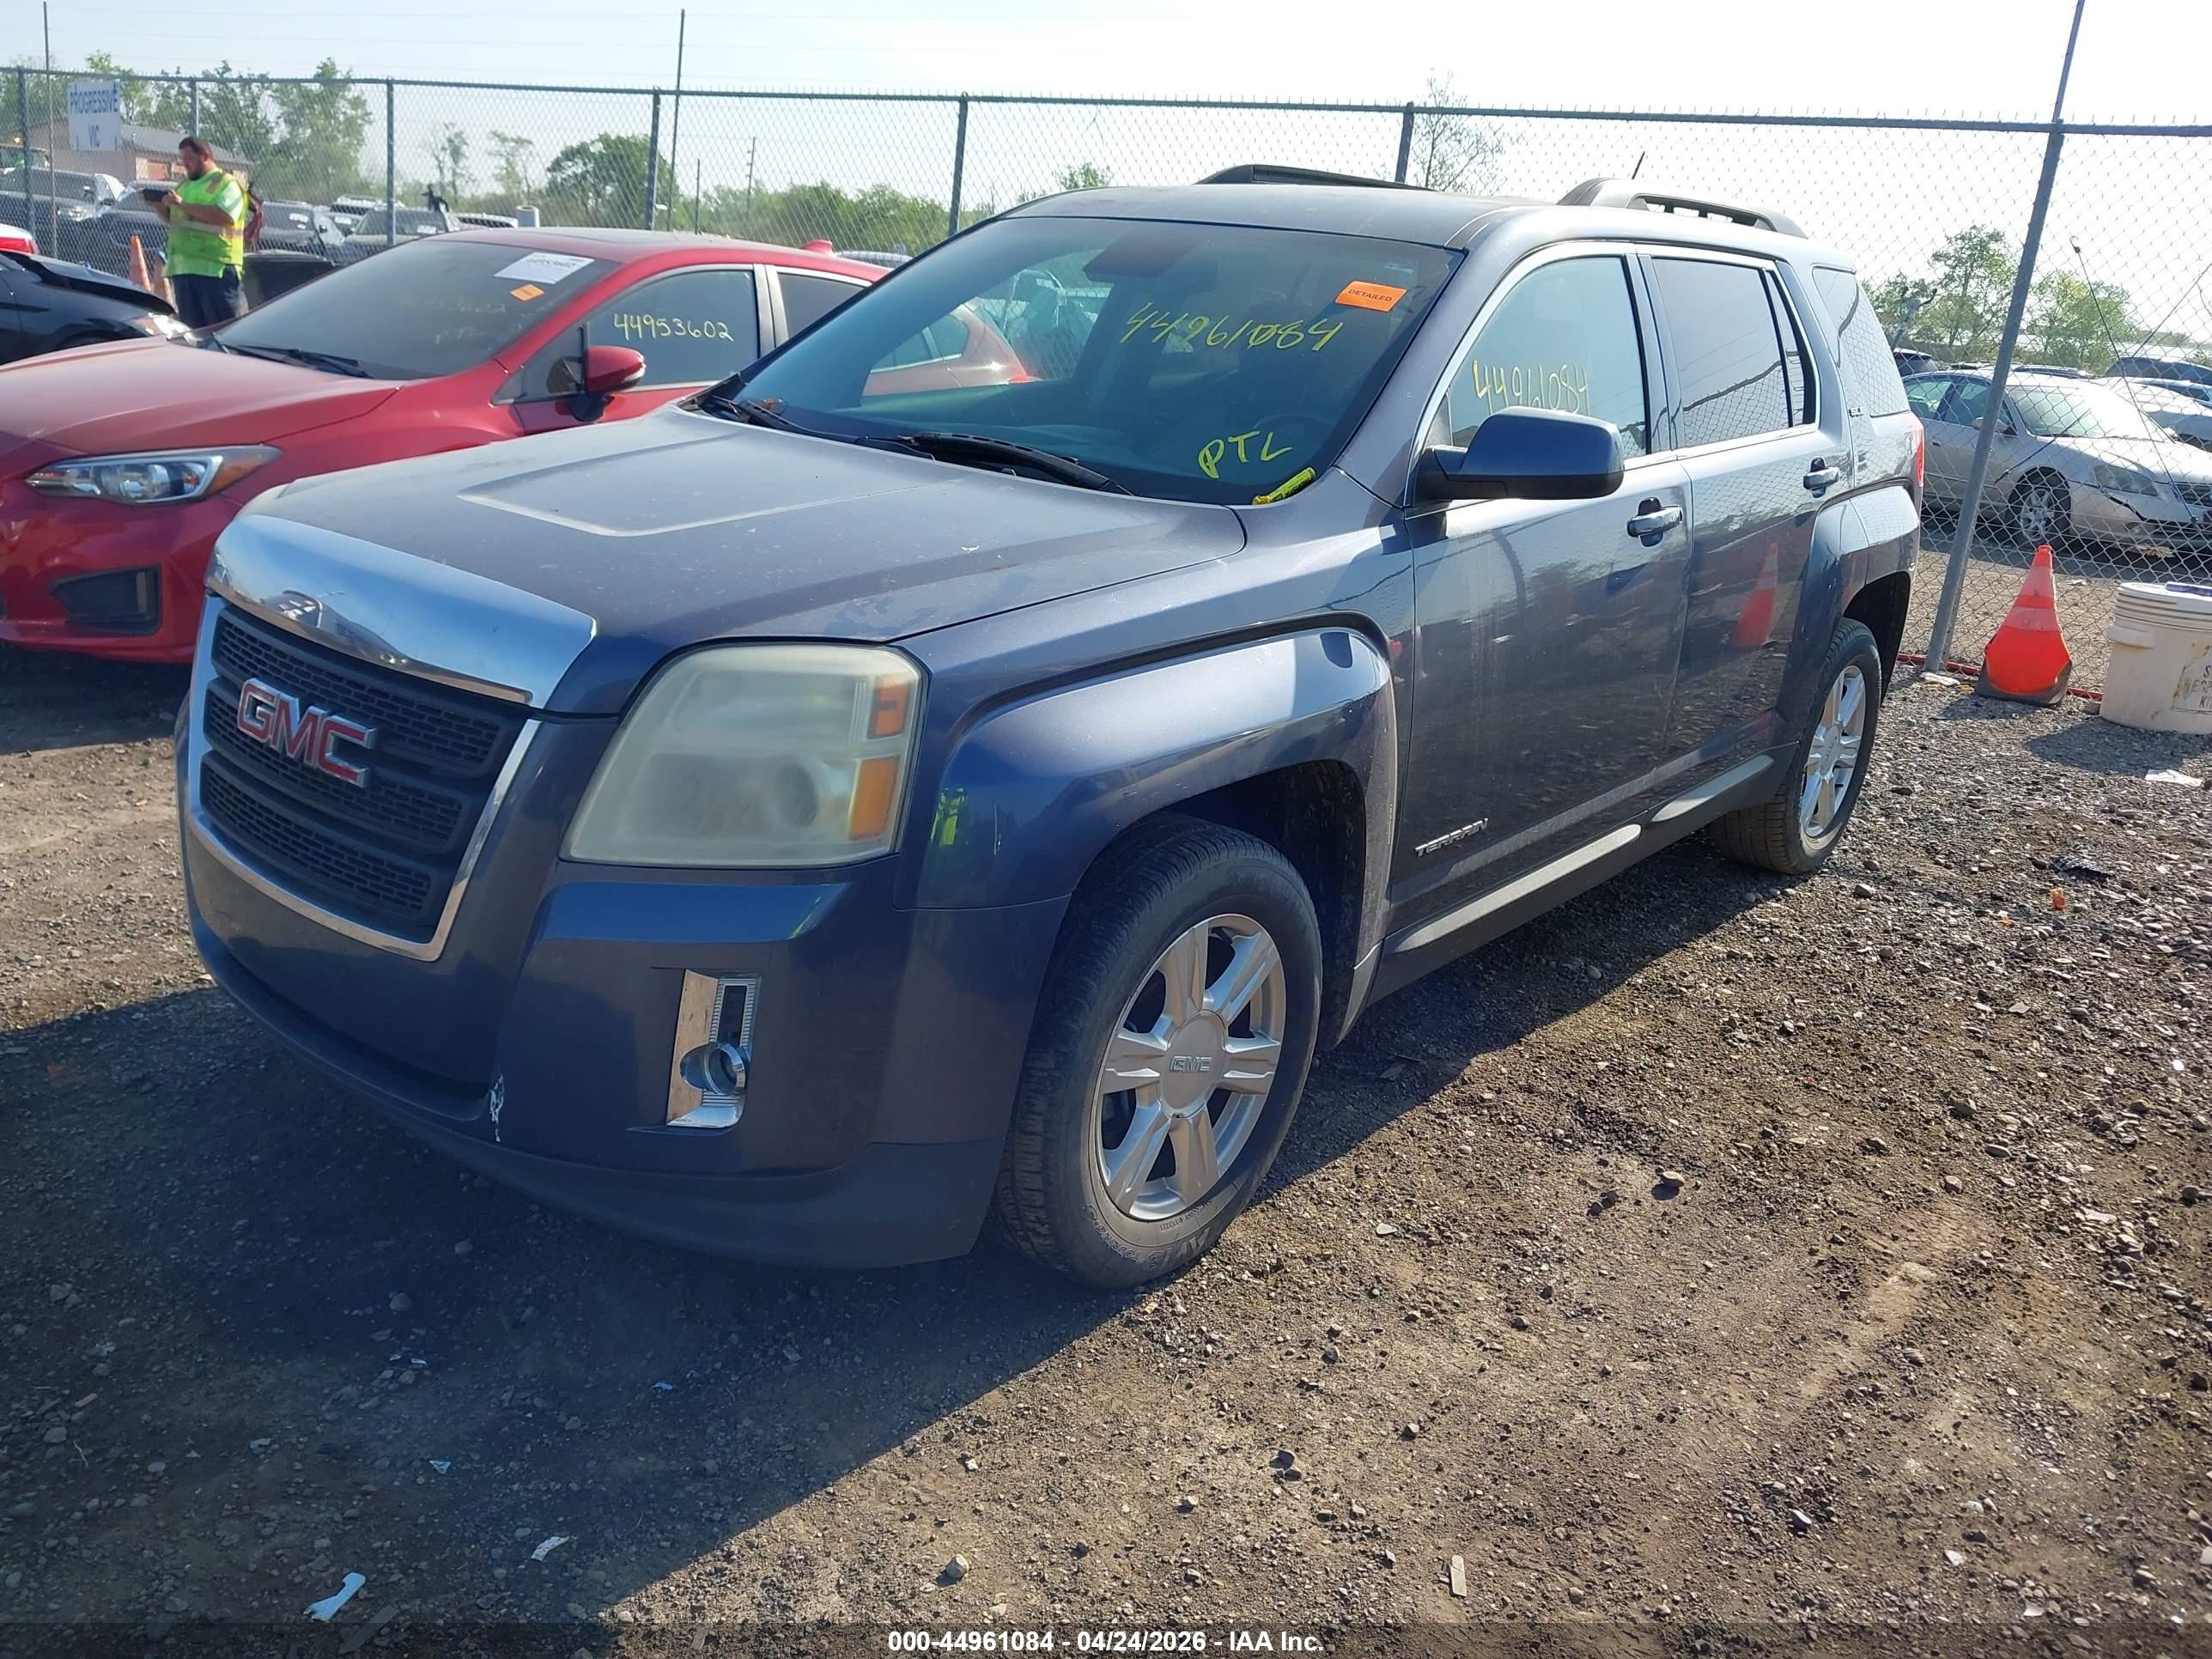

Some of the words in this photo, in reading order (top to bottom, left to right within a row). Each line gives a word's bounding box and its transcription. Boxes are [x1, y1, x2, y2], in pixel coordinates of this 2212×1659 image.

[1348, 289, 1392, 302] DETAILED
[613, 313, 734, 342] 44953602
[1119, 302, 1343, 351] 44961084
[1473, 359, 1590, 416] 44961084
[1199, 430, 1294, 478] PTL
[237, 678, 376, 788] GMC
[1414, 817, 1489, 857] TERRAIN
[1170, 1055, 1212, 1073] GMC
